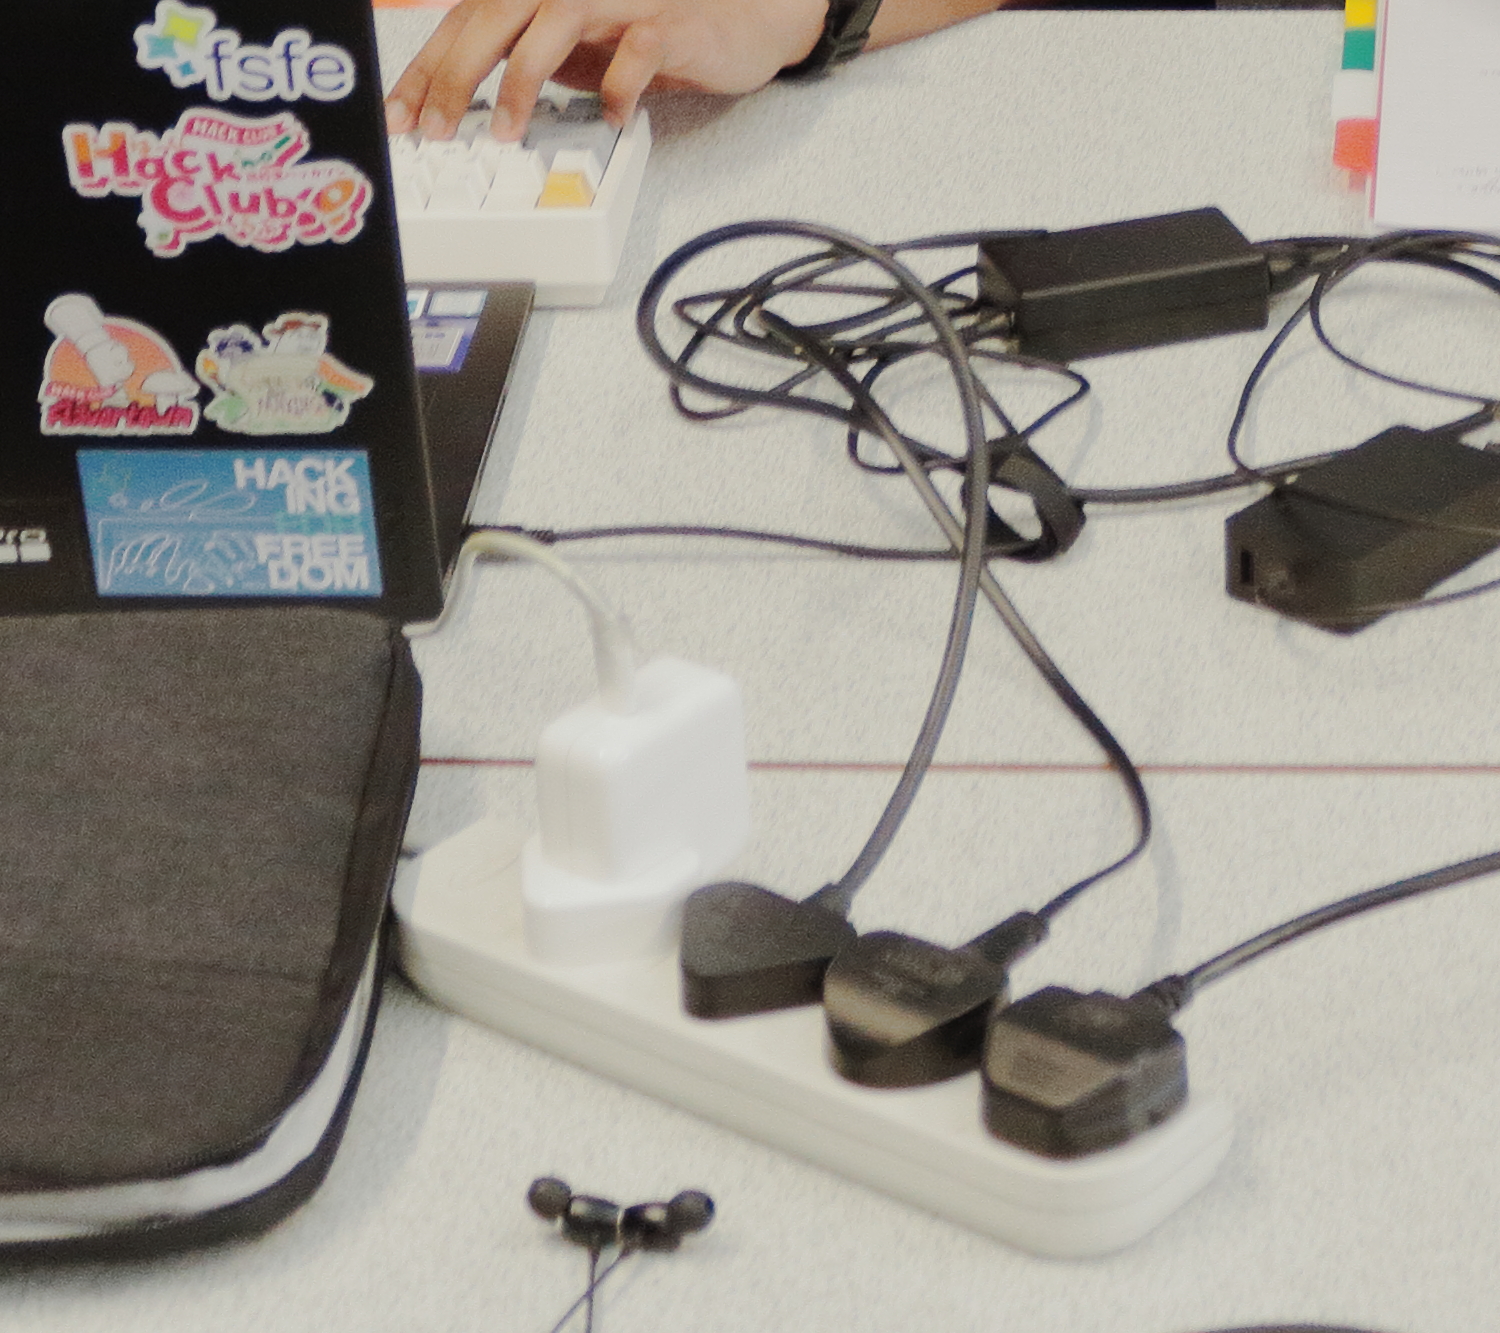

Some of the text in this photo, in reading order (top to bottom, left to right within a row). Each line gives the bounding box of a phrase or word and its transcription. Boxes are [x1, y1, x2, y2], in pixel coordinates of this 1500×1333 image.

[205, 37, 347, 94] fsfe
[71, 132, 242, 184] Hack
[150, 177, 298, 224] Club
[234, 457, 355, 490] HACK
[285, 483, 361, 515] ING
[255, 534, 365, 564] FREE
[268, 559, 370, 590] DOM
